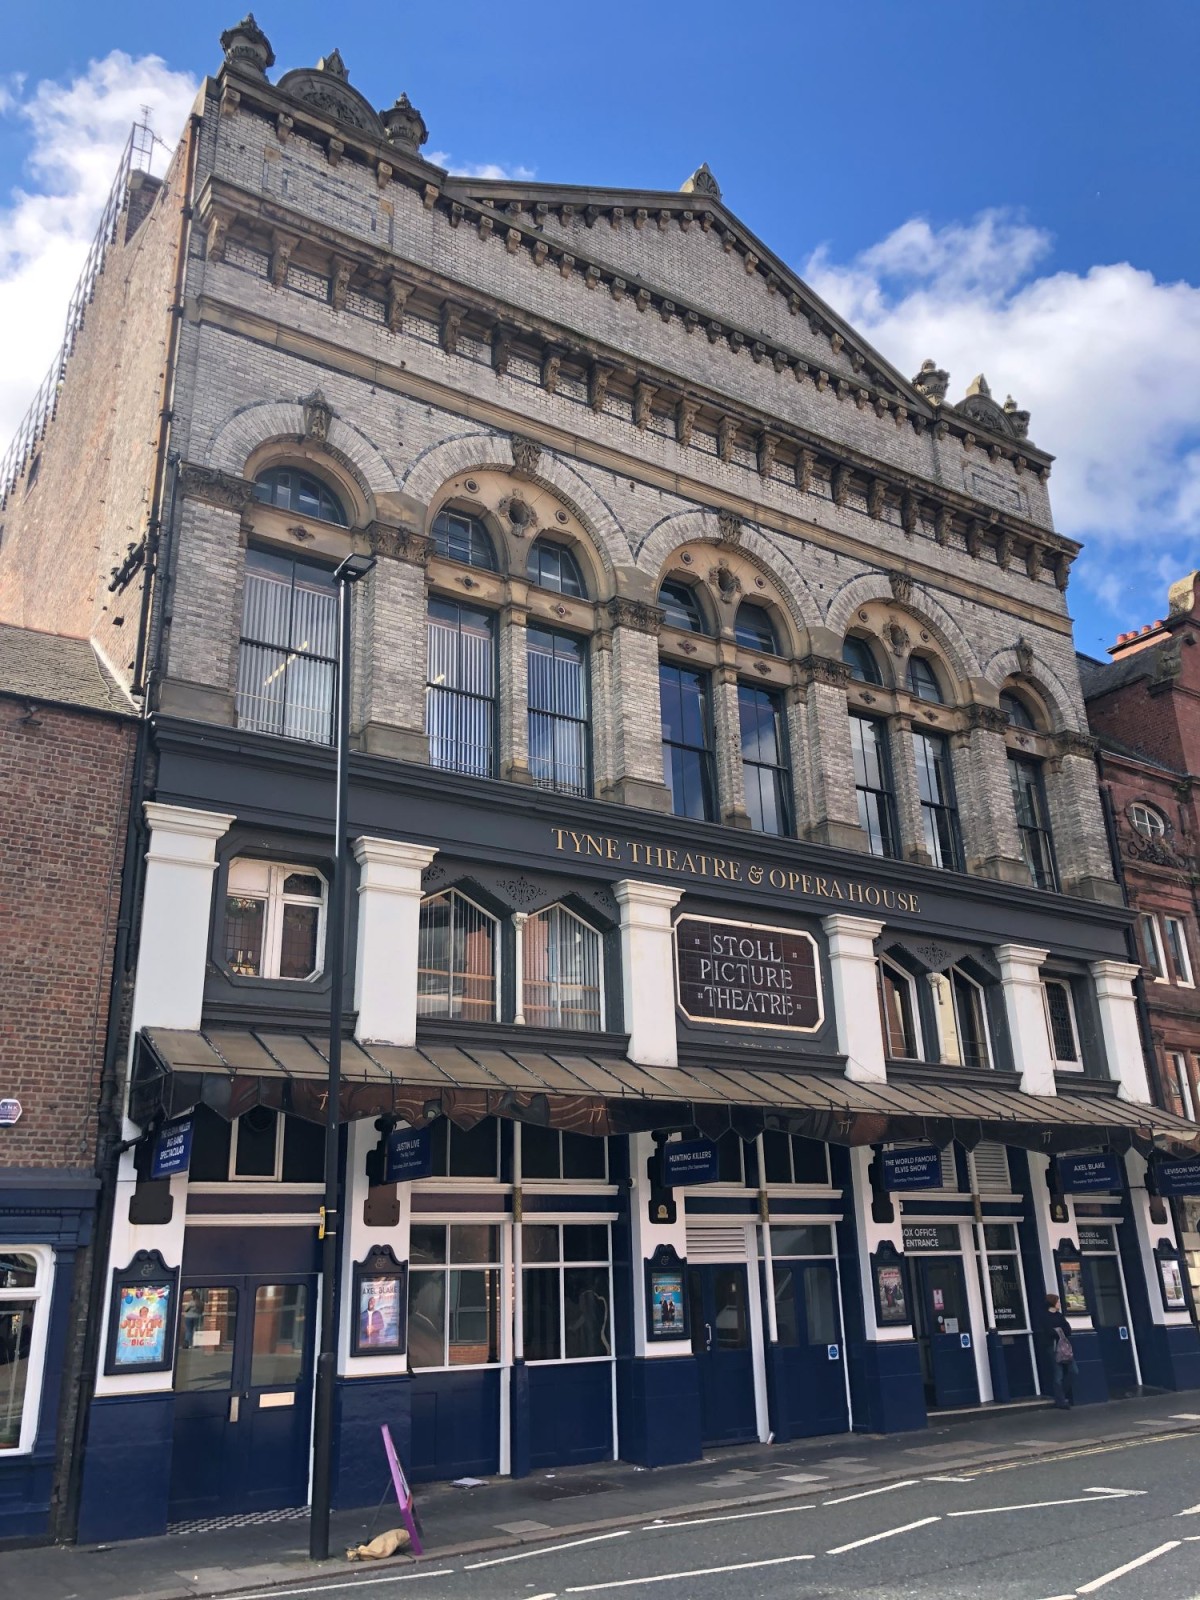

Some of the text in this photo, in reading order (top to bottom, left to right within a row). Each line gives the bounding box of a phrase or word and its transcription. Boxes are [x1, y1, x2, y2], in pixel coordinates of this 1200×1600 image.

[551, 828, 921, 913] TYNE THEATRE & OPERA HOUSE
[712, 934, 782, 962] STOLL
[700, 958, 793, 990] PICTURE
[704, 986, 794, 1016] THEATRE
[396, 1138, 420, 1152] JUSTIN LIVE
[159, 1144, 185, 1161] SPECTACULAR
[669, 1150, 712, 1162] HUNTING KILLERS
[885, 1154, 938, 1167] THE WORLD FAMOUS
[895, 1163, 928, 1174] ELVIS SHOW
[1073, 1161, 1106, 1172] AXEL BLAKE
[1164, 1167, 1188, 1175] LEVISON
[902, 1228, 937, 1237] OX OFFICE
[906, 1238, 939, 1247] ENTRANCE
[120, 1319, 163, 1329] JUSTIN
[126, 1327, 155, 1338] LIVE
[130, 1338, 145, 1347] BIG
